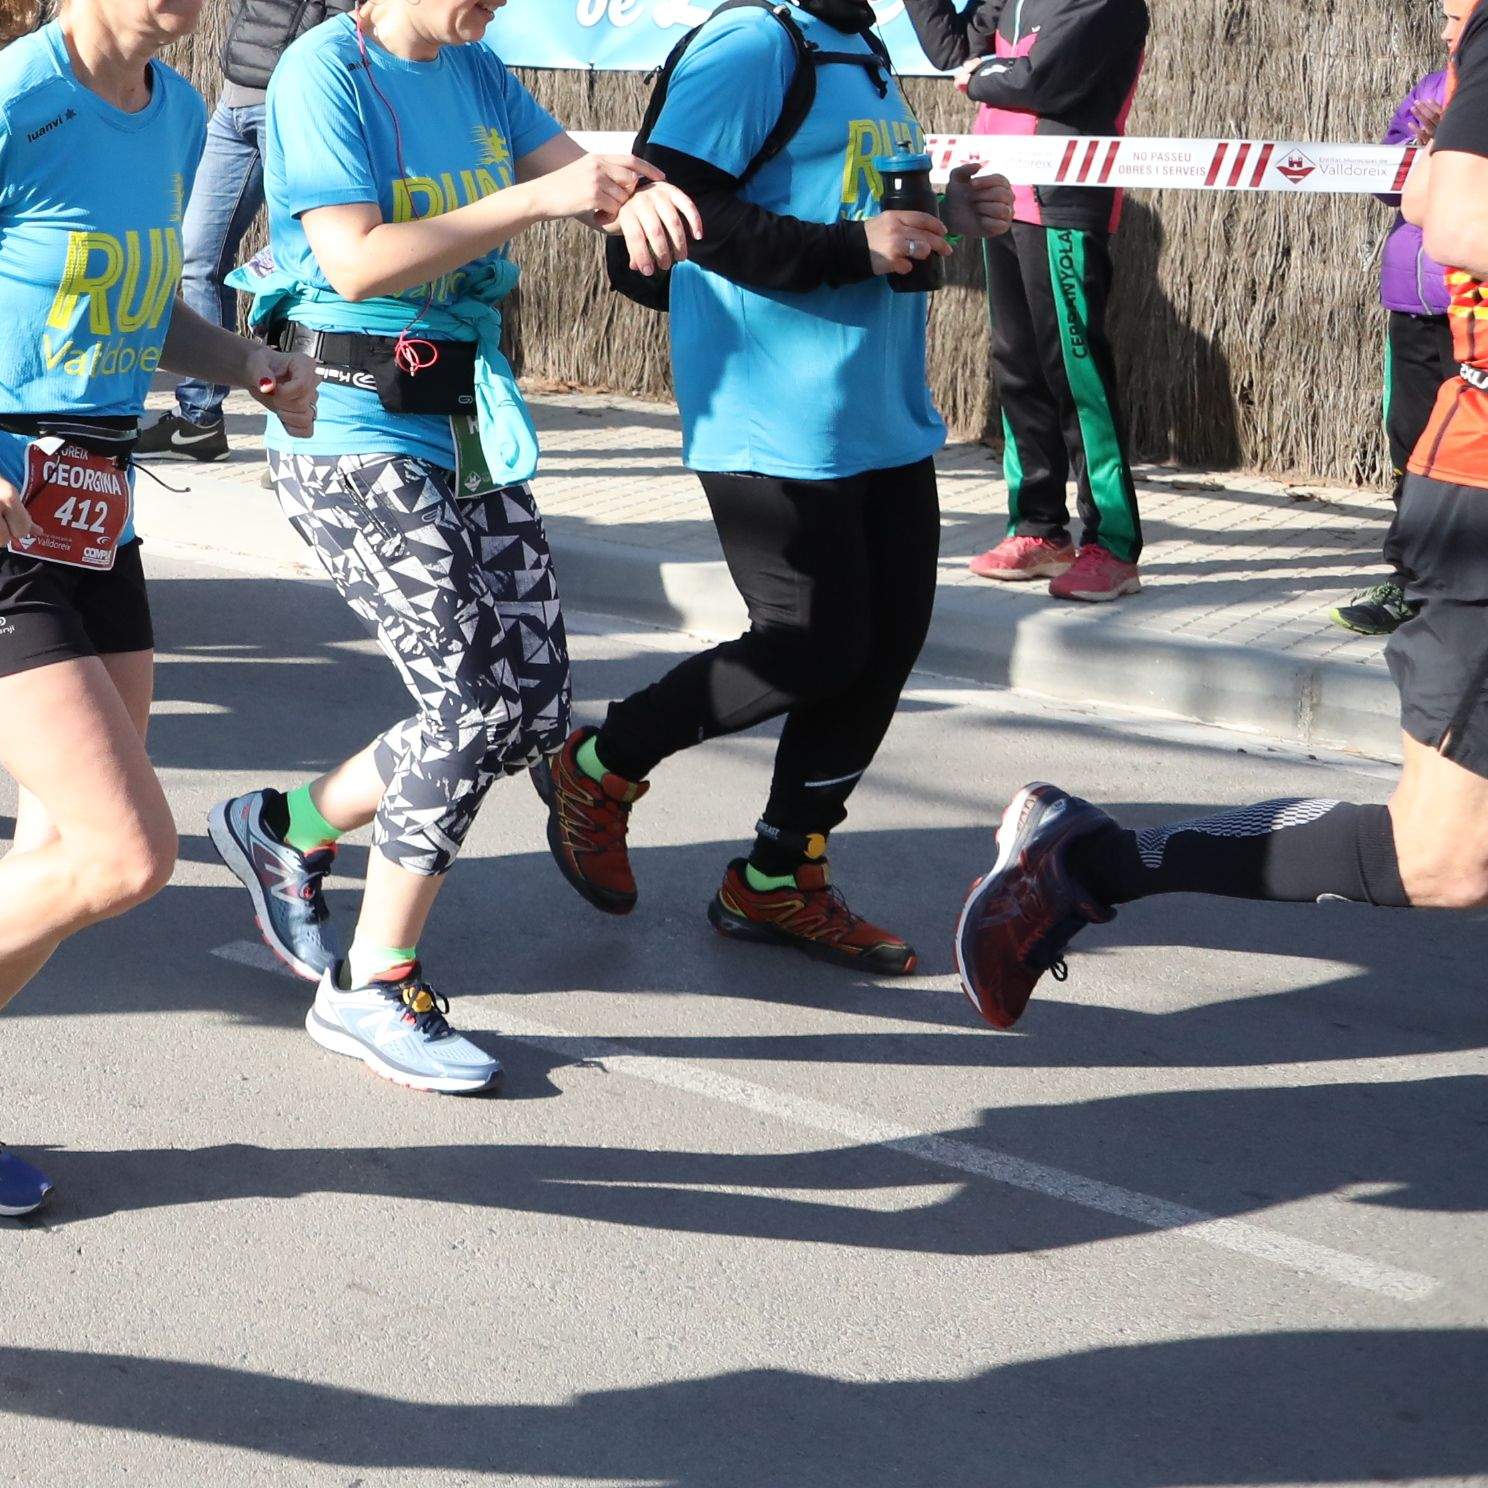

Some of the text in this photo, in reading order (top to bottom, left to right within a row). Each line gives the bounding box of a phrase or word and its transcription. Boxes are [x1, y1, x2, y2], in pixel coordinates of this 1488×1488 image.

[27, 113, 64, 144] luanvi
[1132, 151, 1192, 163] NO PASSEU
[1118, 165, 1153, 176] OBRES
[1162, 165, 1207, 178] SERVEIS
[1318, 162, 1388, 177] Valldoreix
[42, 460, 122, 495] GEORGINA
[53, 496, 108, 534] 412
[37, 535, 71, 552] Valldoreix
